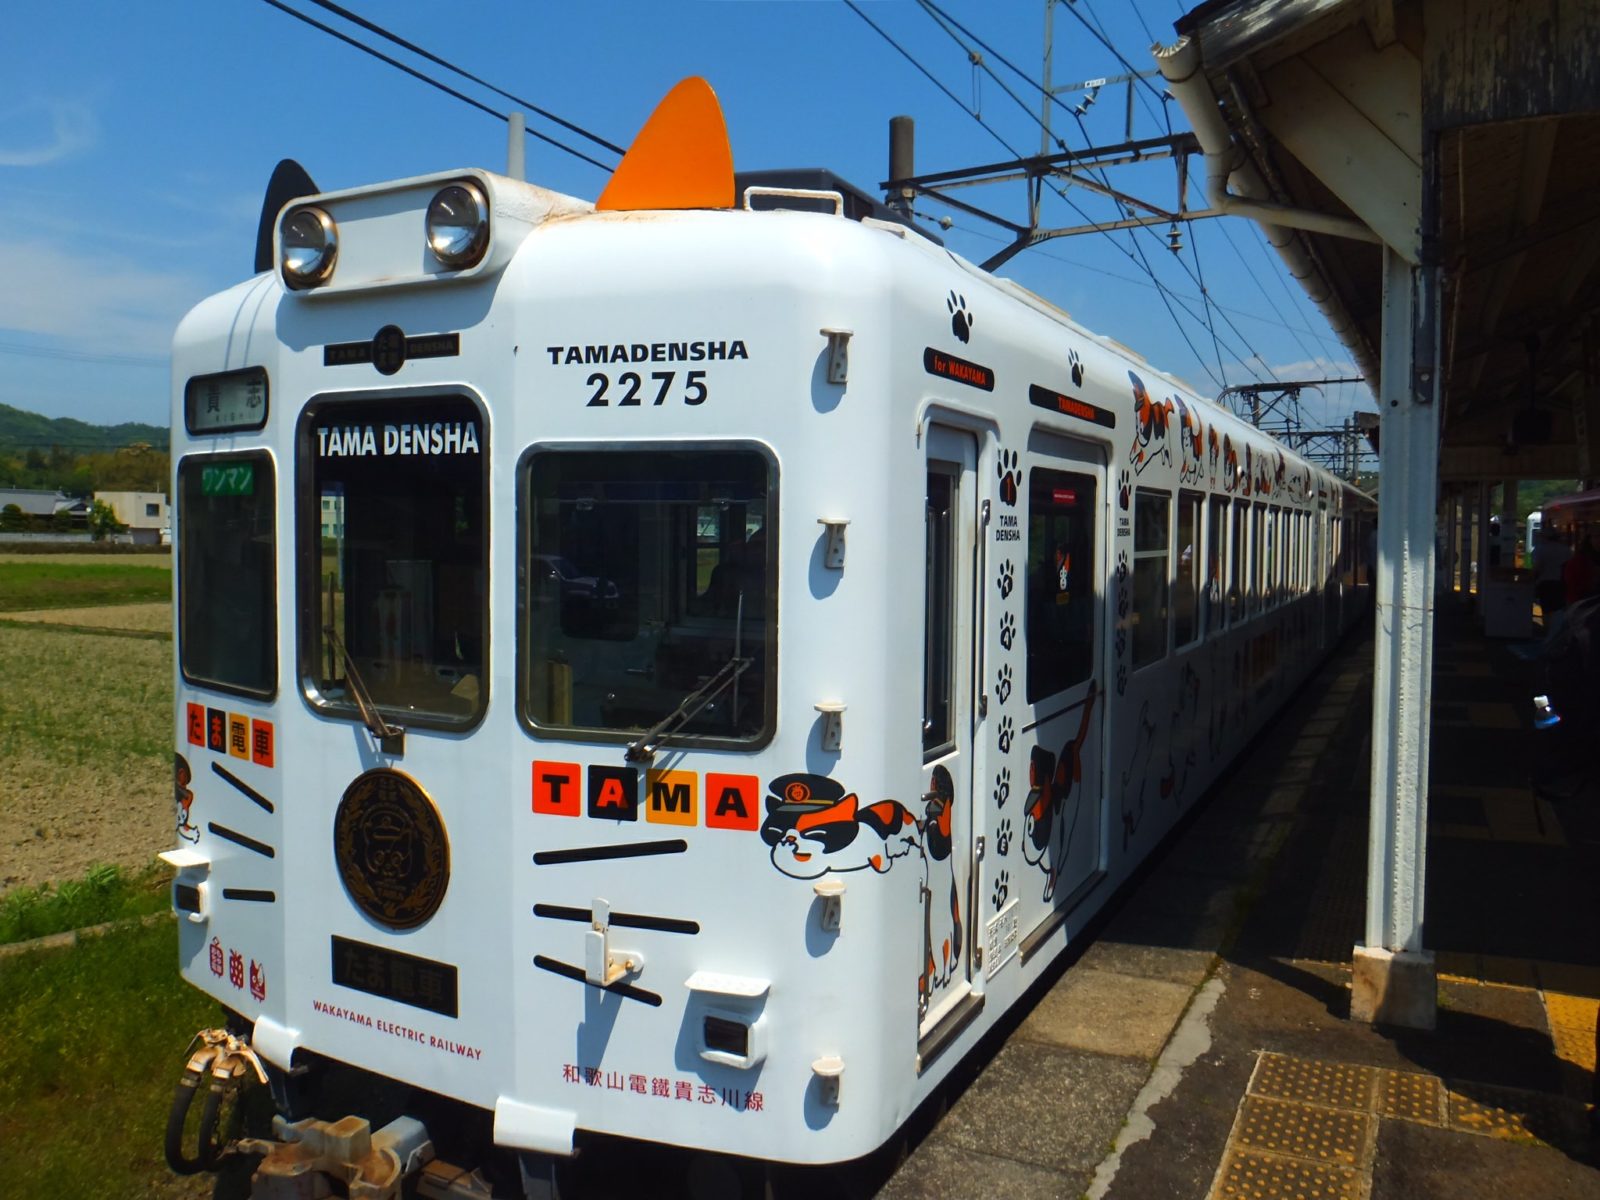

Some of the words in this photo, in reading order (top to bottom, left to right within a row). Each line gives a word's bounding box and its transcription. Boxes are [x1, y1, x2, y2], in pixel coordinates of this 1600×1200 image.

[547, 341, 749, 365] TAMADENSHA
[934, 355, 946, 373] for
[949, 359, 986, 386] WAKAYAMA
[586, 371, 708, 407] 2275
[317, 425, 377, 457] TAMA
[383, 422, 480, 455] DENSHA
[202, 467, 252, 490] ワンマン
[995, 529, 1021, 542] DENSHA
[999, 515, 1018, 527] TAMA
[190, 710, 270, 759] たま電車
[312, 1000, 373, 1028] WAKAYAMA
[377, 1019, 426, 1044] ELECTRIC
[430, 1036, 482, 1061] RAILWAY
[562, 1063, 764, 1112] 和歌山電鐵貴志川線
